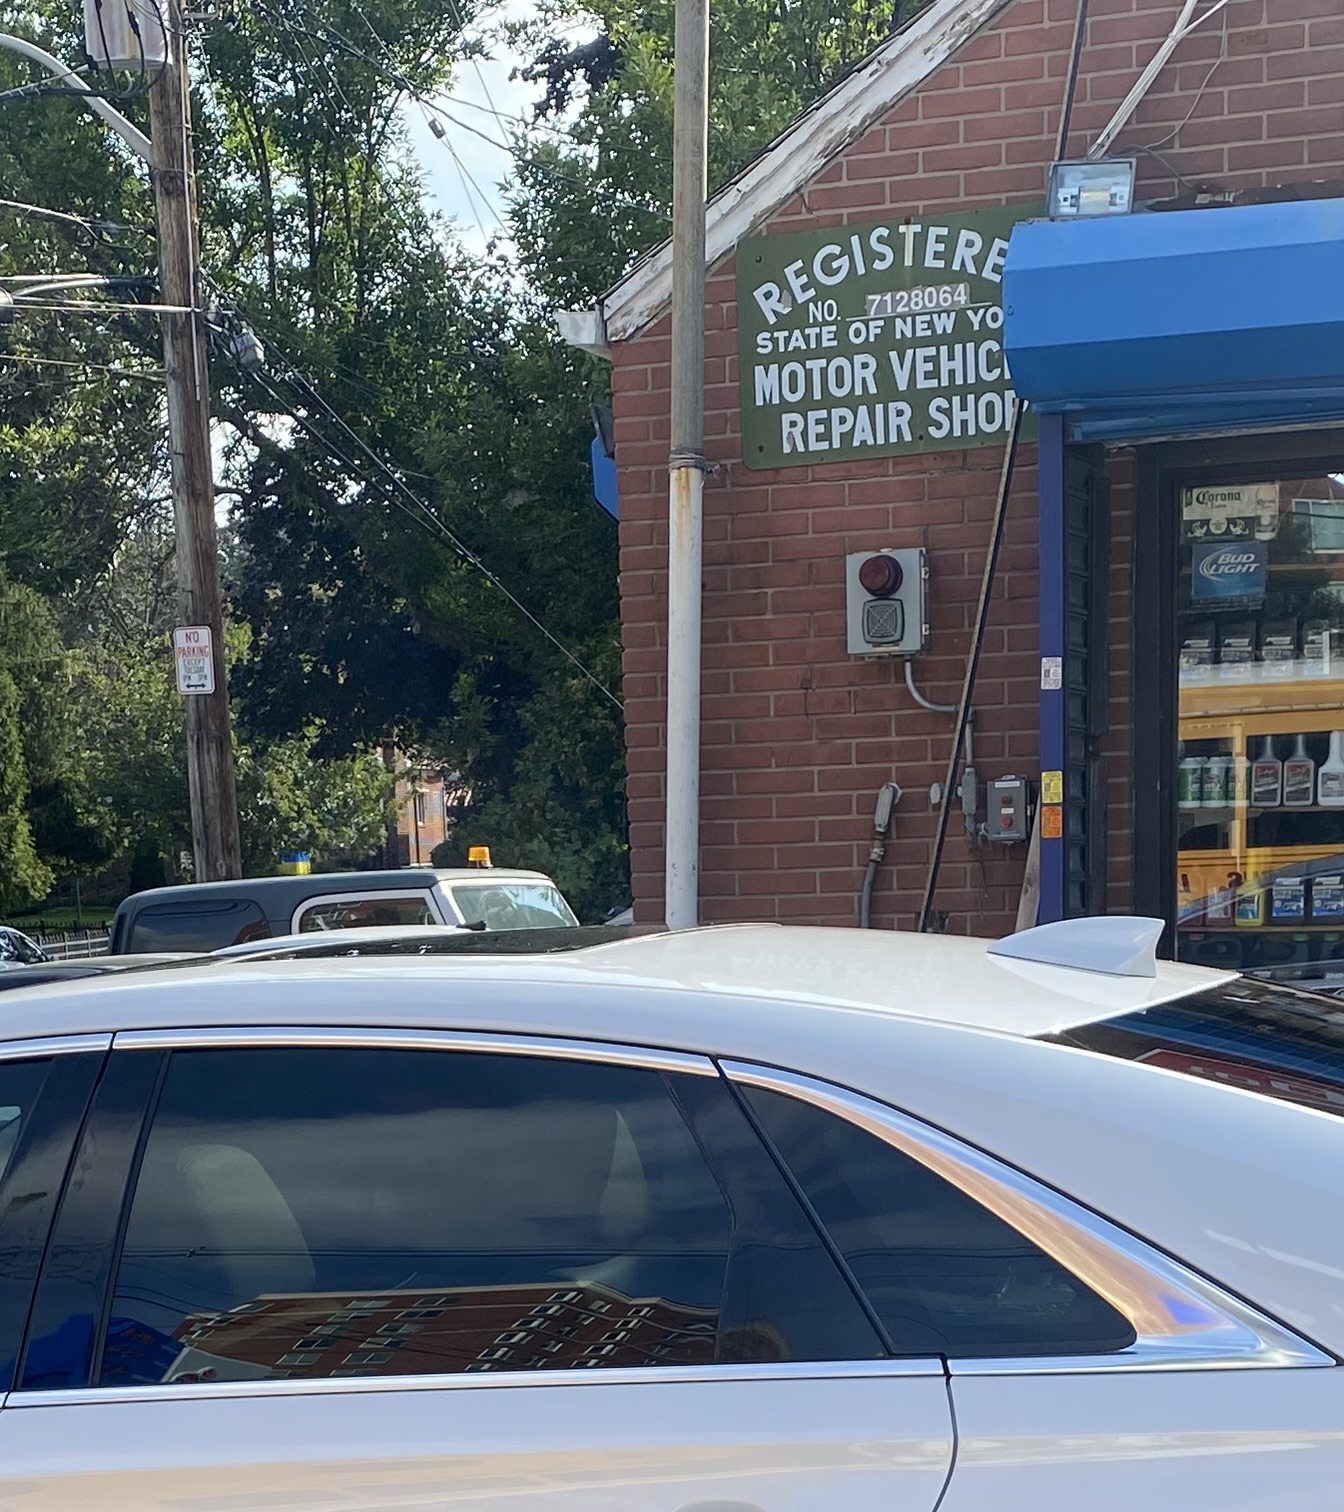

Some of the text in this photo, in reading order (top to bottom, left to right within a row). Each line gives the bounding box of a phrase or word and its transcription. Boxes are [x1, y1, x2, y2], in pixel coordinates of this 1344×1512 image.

[753, 224, 1009, 325] REGISTERE
[809, 283, 968, 323] NO. 7128064
[756, 306, 1004, 354] STATE OF NEW YO
[754, 353, 878, 407] MOTOR
[782, 400, 913, 454] REPAIR
[1196, 489, 1241, 506] Corona
[1210, 563, 1260, 575] LIGHT
[1218, 553, 1256, 564] BUD
[185, 631, 199, 643] NO
